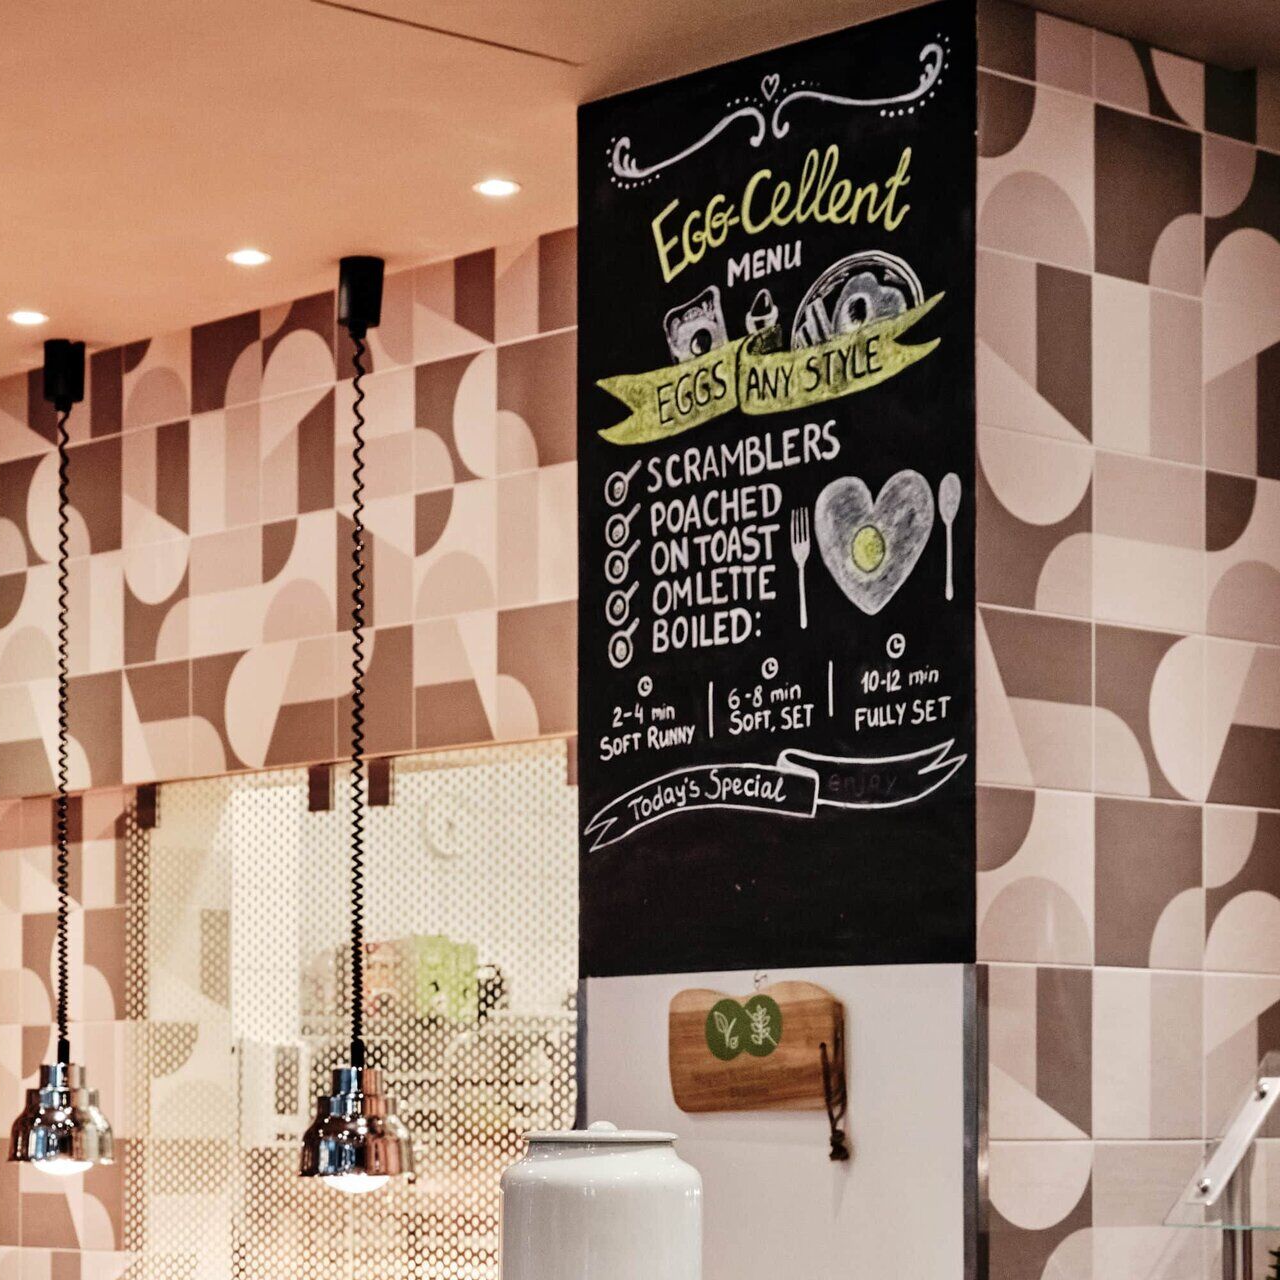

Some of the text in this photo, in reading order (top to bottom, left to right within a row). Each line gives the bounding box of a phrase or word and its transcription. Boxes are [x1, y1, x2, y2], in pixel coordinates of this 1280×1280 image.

[727, 240, 802, 287] MENU
[657, 336, 882, 425] EGGS ANY STYLE
[647, 420, 841, 492] SCRAMBLERS
[651, 483, 782, 535] POACHED
[651, 523, 781, 576] ON TOAST
[652, 564, 776, 616] OMLETTE
[653, 607, 762, 653] BOILED:
[728, 682, 802, 710] 6-8 min
[861, 666, 941, 693] 10-12 min
[613, 703, 677, 727] 2-4 min
[781, 703, 815, 730] SET
[855, 696, 952, 732] FULLY SET
[600, 724, 696, 761] SOFT RUNNY
[628, 769, 788, 822] Today's Special
